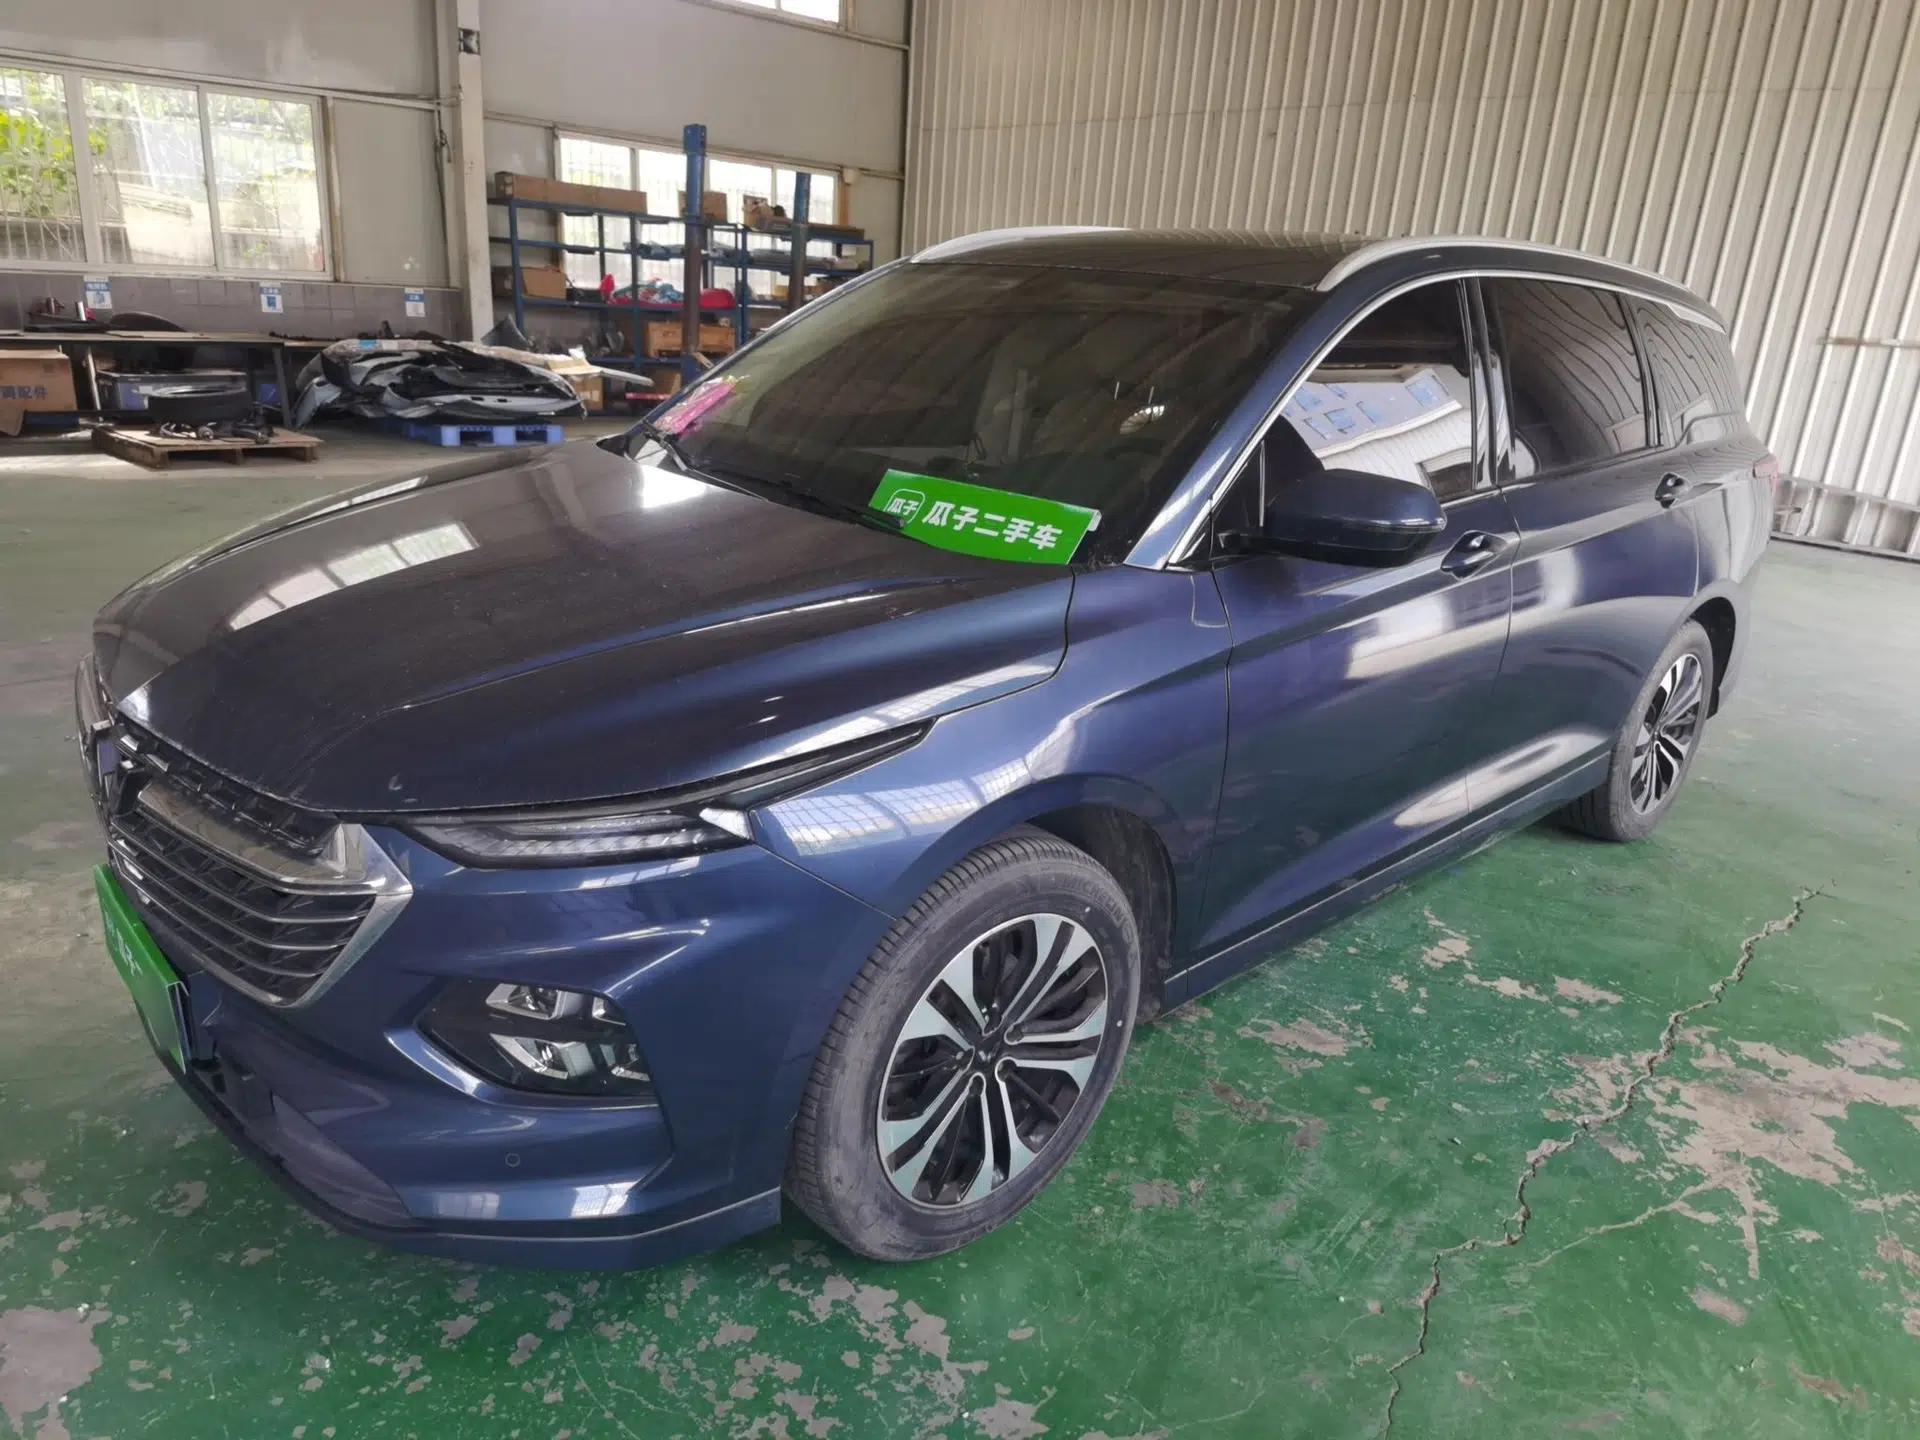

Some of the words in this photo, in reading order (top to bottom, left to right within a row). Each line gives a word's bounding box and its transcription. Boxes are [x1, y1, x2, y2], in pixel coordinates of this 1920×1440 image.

[889, 498, 918, 515] 瓜子
[922, 500, 1063, 549] 瓜子二手车
